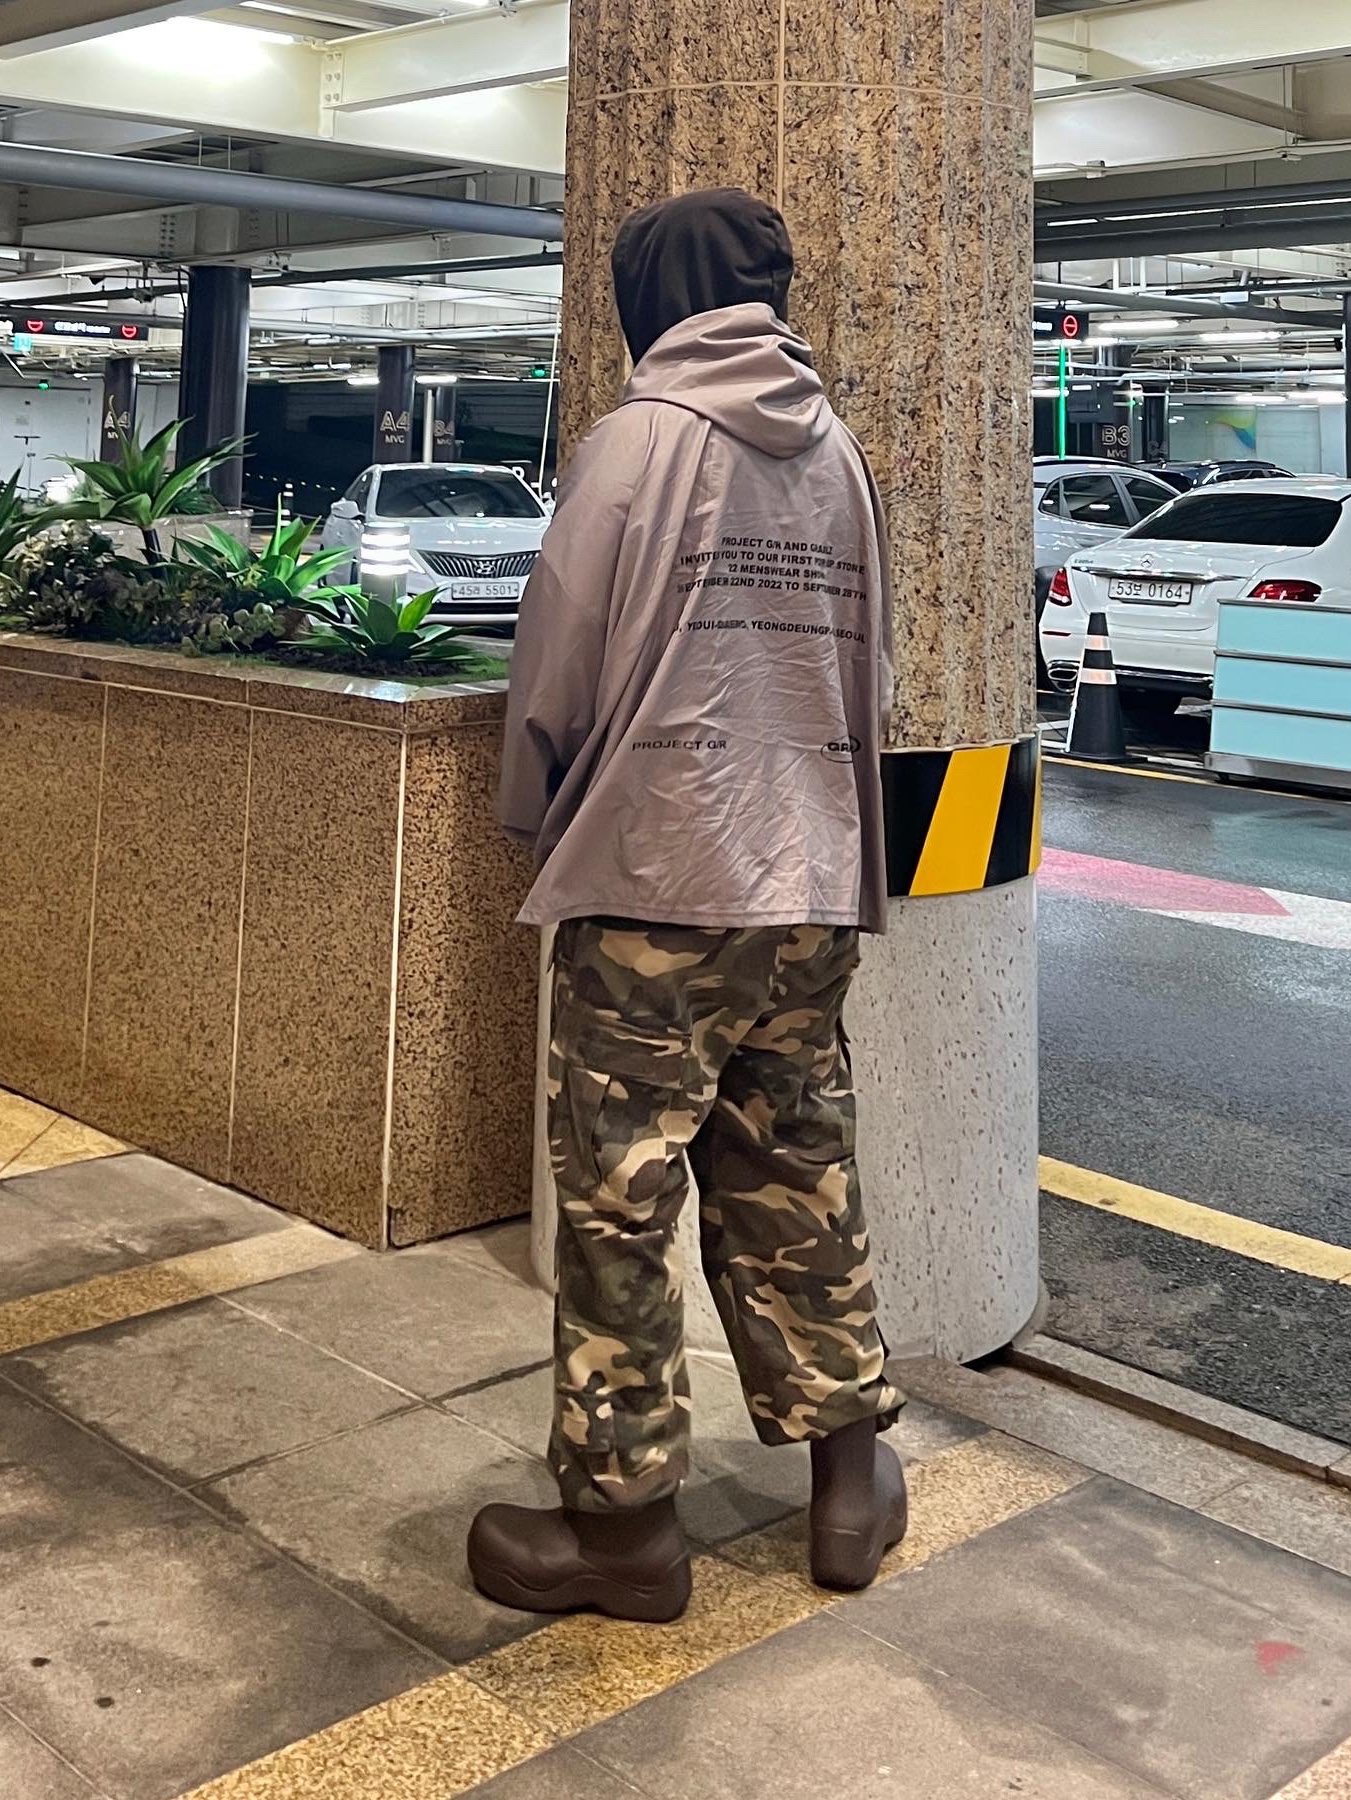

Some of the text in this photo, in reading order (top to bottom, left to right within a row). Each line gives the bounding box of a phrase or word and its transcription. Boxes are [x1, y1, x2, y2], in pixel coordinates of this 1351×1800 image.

[380, 411, 410, 432] A4
[1102, 424, 1130, 446] B3
[1107, 449, 1127, 459] MVG
[721, 537, 764, 548] PROJECT
[783, 541, 808, 552] AND
[720, 551, 738, 560] YOU
[740, 551, 755, 560] TO
[757, 553, 779, 563] OUR
[780, 554, 813, 566] FIRST
[728, 563, 738, 573] 22
[740, 564, 800, 578] MENSWEAR
[485, 584, 512, 596] 5501
[730, 577, 755, 588] 22ND
[757, 579, 783, 590] 2022
[785, 582, 800, 591] TO
[1148, 583, 1183, 599] 0164
[631, 740, 703, 751] PROJECT
